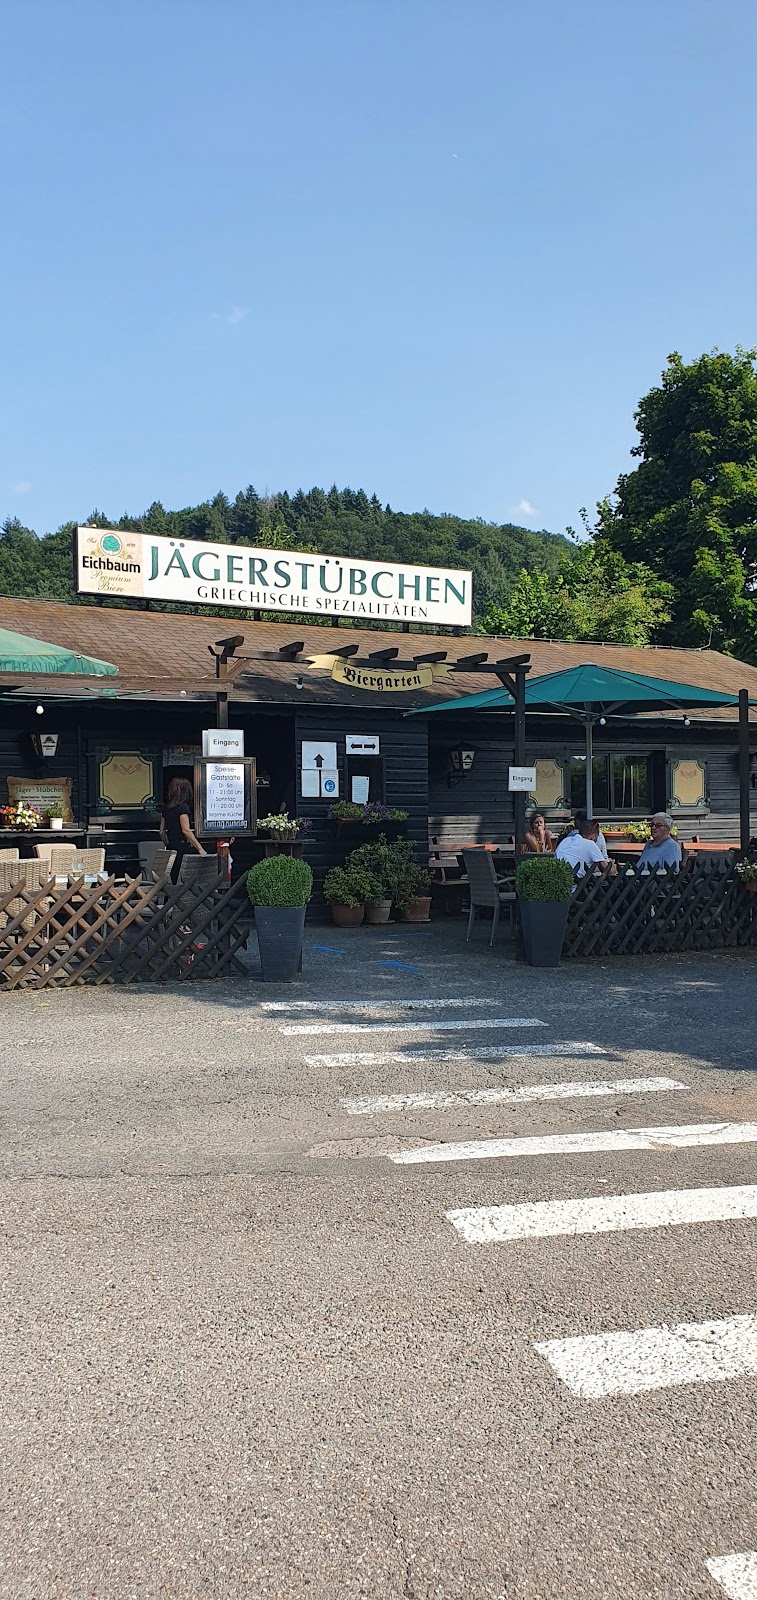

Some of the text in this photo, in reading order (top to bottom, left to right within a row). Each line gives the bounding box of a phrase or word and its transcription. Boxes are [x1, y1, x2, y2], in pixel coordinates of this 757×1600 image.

[82, 555, 141, 573] Eichbaum
[91, 569, 131, 583] Premium
[148, 541, 466, 605] JÄGERSTÜBCHEN
[98, 580, 125, 592] Biere
[197, 585, 428, 618] GRIECHISCHE SPEZIALITÄTEN
[342, 667, 422, 691] Biergarten
[213, 739, 240, 747] Eingang
[214, 765, 237, 773] Speise-
